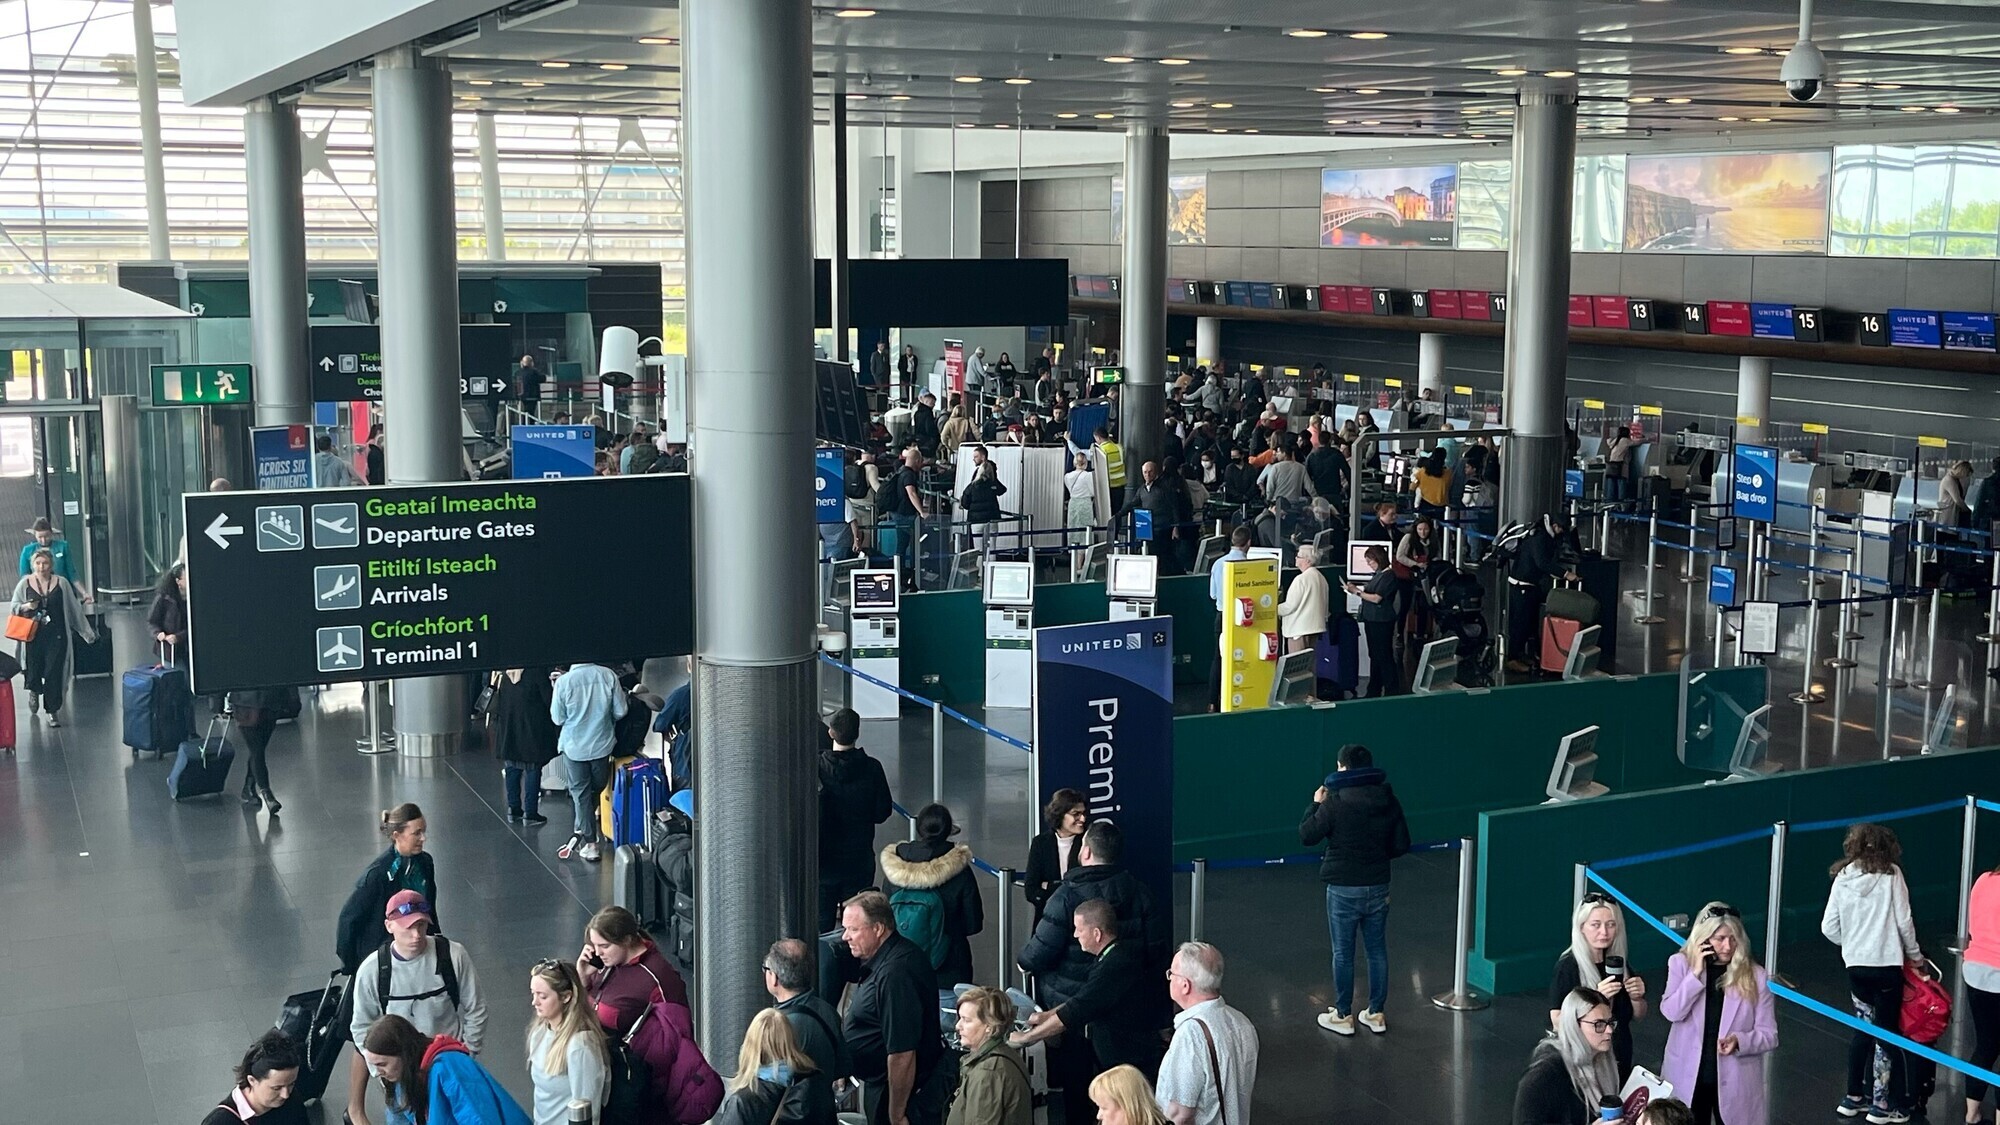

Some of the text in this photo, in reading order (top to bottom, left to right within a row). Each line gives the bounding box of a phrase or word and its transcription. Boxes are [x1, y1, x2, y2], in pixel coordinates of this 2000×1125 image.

[1111, 279, 1118, 291] 3
[1188, 283, 1195, 295] 5
[1213, 285, 1220, 296] 6
[1276, 287, 1282, 300] 7
[1306, 288, 1312, 301] 8
[1378, 292, 1385, 305] 9
[1412, 294, 1424, 307] 10
[1494, 297, 1505, 311] 11
[1632, 303, 1647, 319] 13
[1685, 306, 1699, 322] 14
[1758, 309, 1784, 317] UNITED
[1897, 316, 1927, 324] UNITED
[1798, 313, 1815, 329] 15
[1862, 316, 1879, 332] 16
[258, 458, 307, 477] ACROSS SIX
[260, 473, 308, 489] CONTINENTS
[1736, 473, 1751, 485] Step
[365, 491, 537, 518] Geataí Imeachta
[816, 498, 836, 506] here
[1735, 490, 1767, 505] Bag drop
[366, 520, 536, 548] Departure Gates
[368, 553, 497, 578] Eitiltí Isteach
[1251, 579, 1275, 587] Sanitiser
[369, 583, 449, 605] Arrivals
[370, 614, 489, 639] Críochfort 1
[1062, 639, 1123, 653] UNITED
[371, 641, 478, 666] Terminal 1
